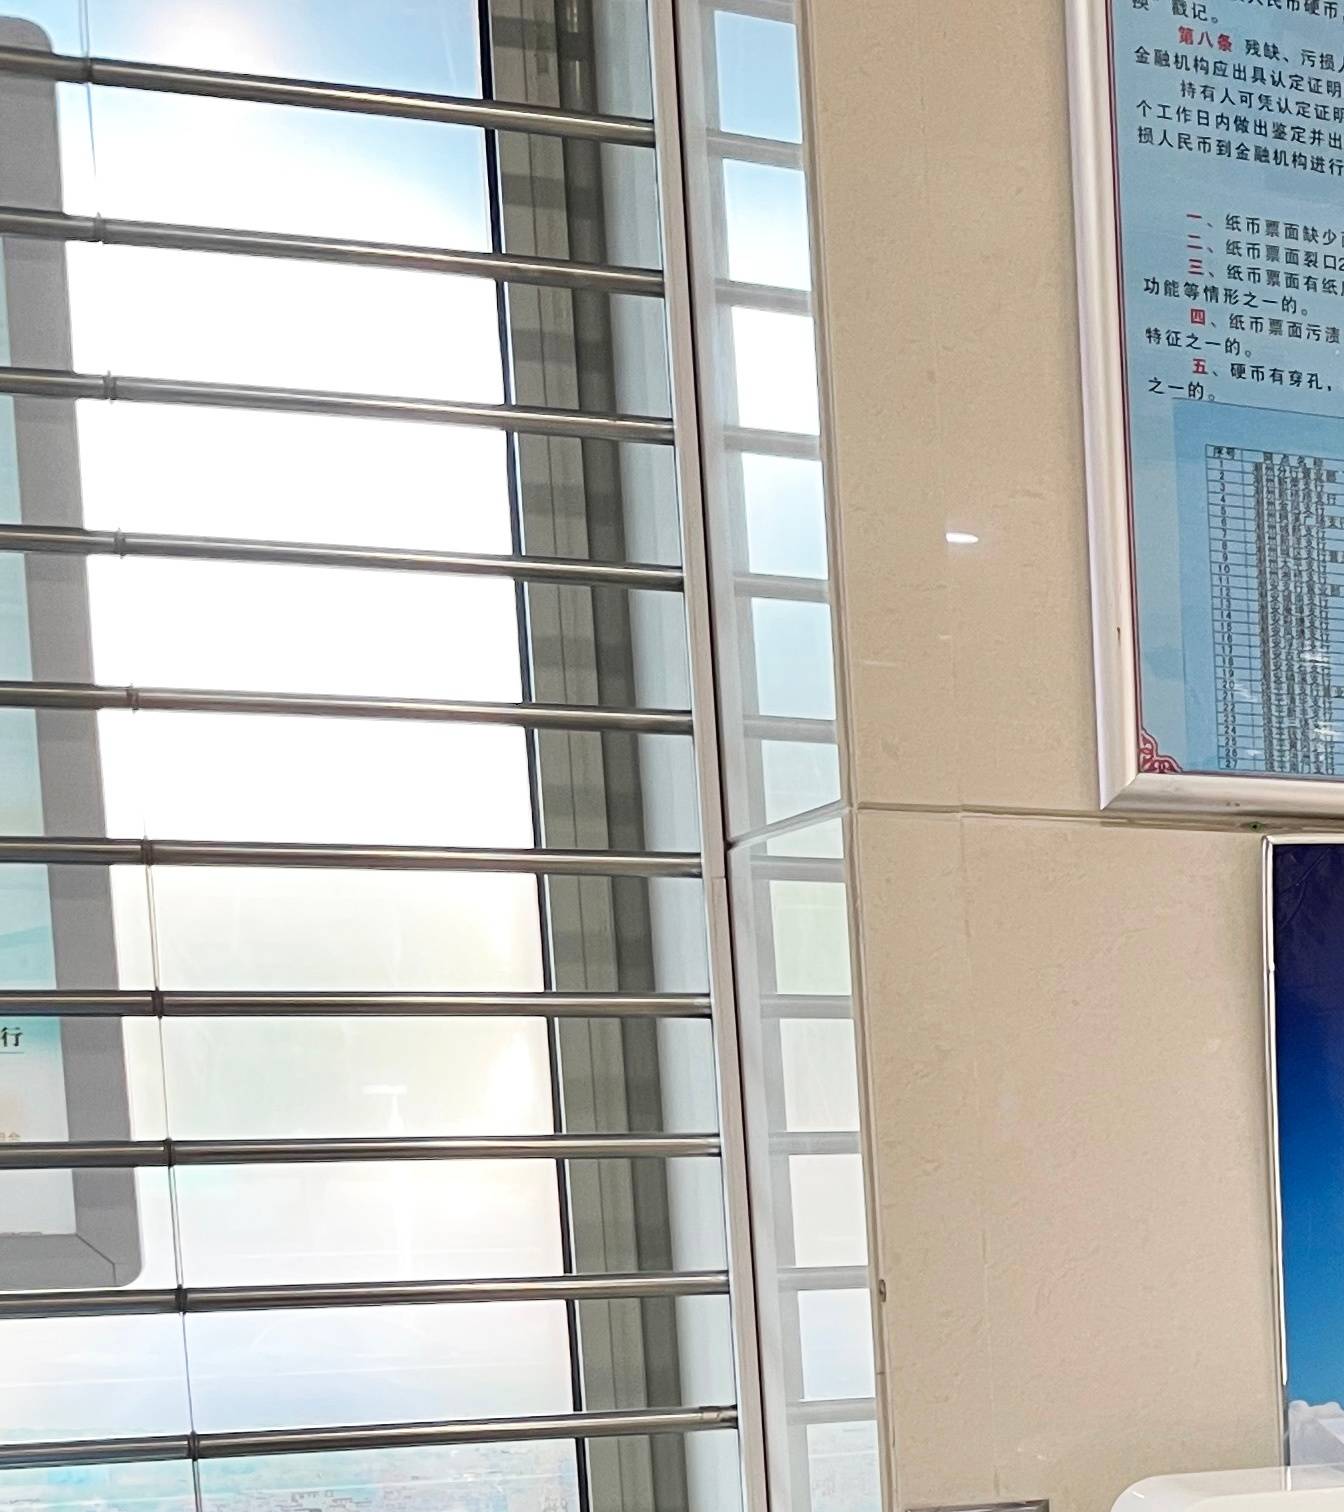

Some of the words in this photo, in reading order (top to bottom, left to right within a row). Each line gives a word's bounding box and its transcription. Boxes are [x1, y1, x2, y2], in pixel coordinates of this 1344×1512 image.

[1177, 25, 1233, 53] 第八条
[1143, 276, 1309, 318] 功能等情形之一的。
[1145, 328, 1252, 359] 特征之一的。
[1148, 377, 1216, 402] 之一的。
